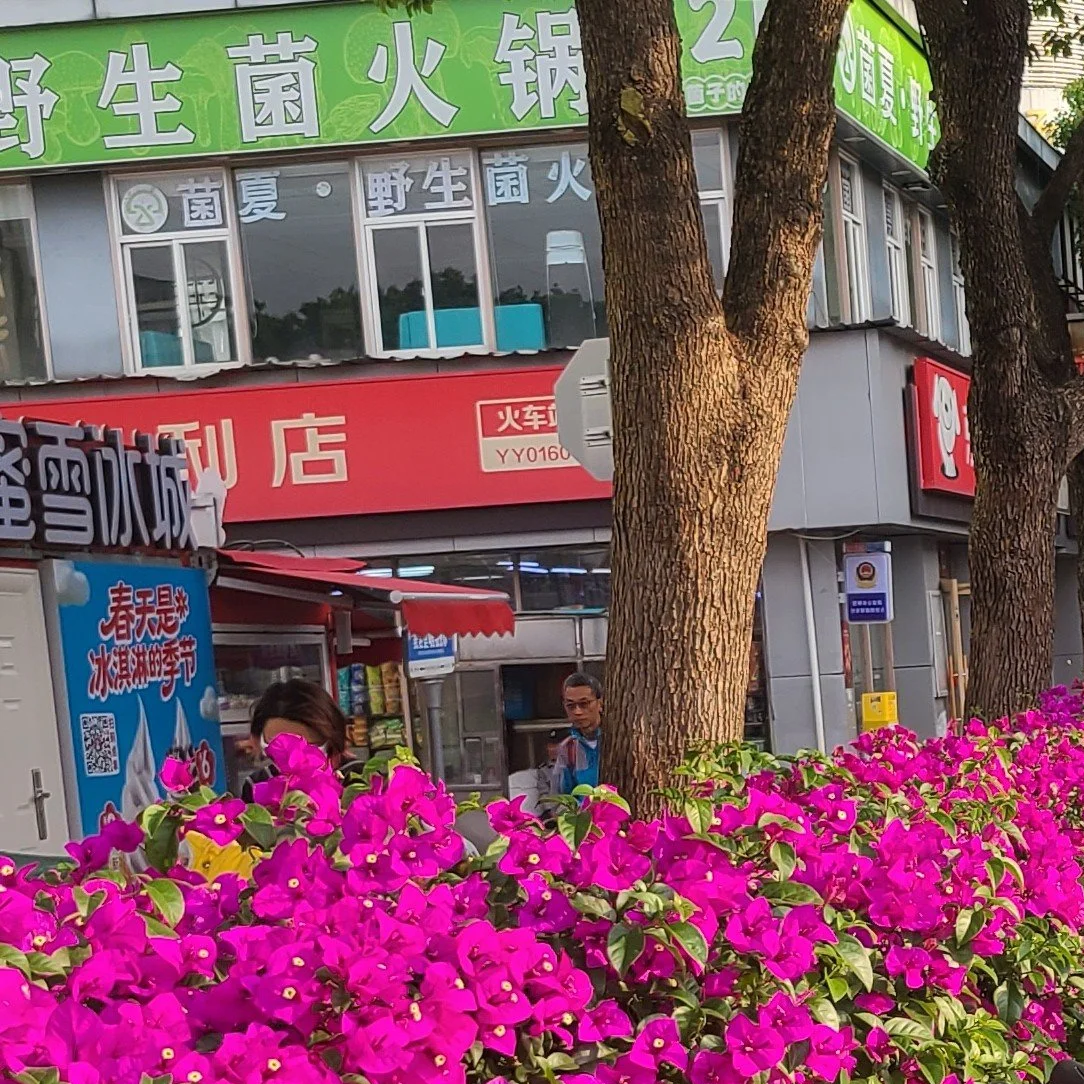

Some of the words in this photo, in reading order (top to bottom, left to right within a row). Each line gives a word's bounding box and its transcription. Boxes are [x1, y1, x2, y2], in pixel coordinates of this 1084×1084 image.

[88, 636, 197, 700] 冰淇淋的季节
